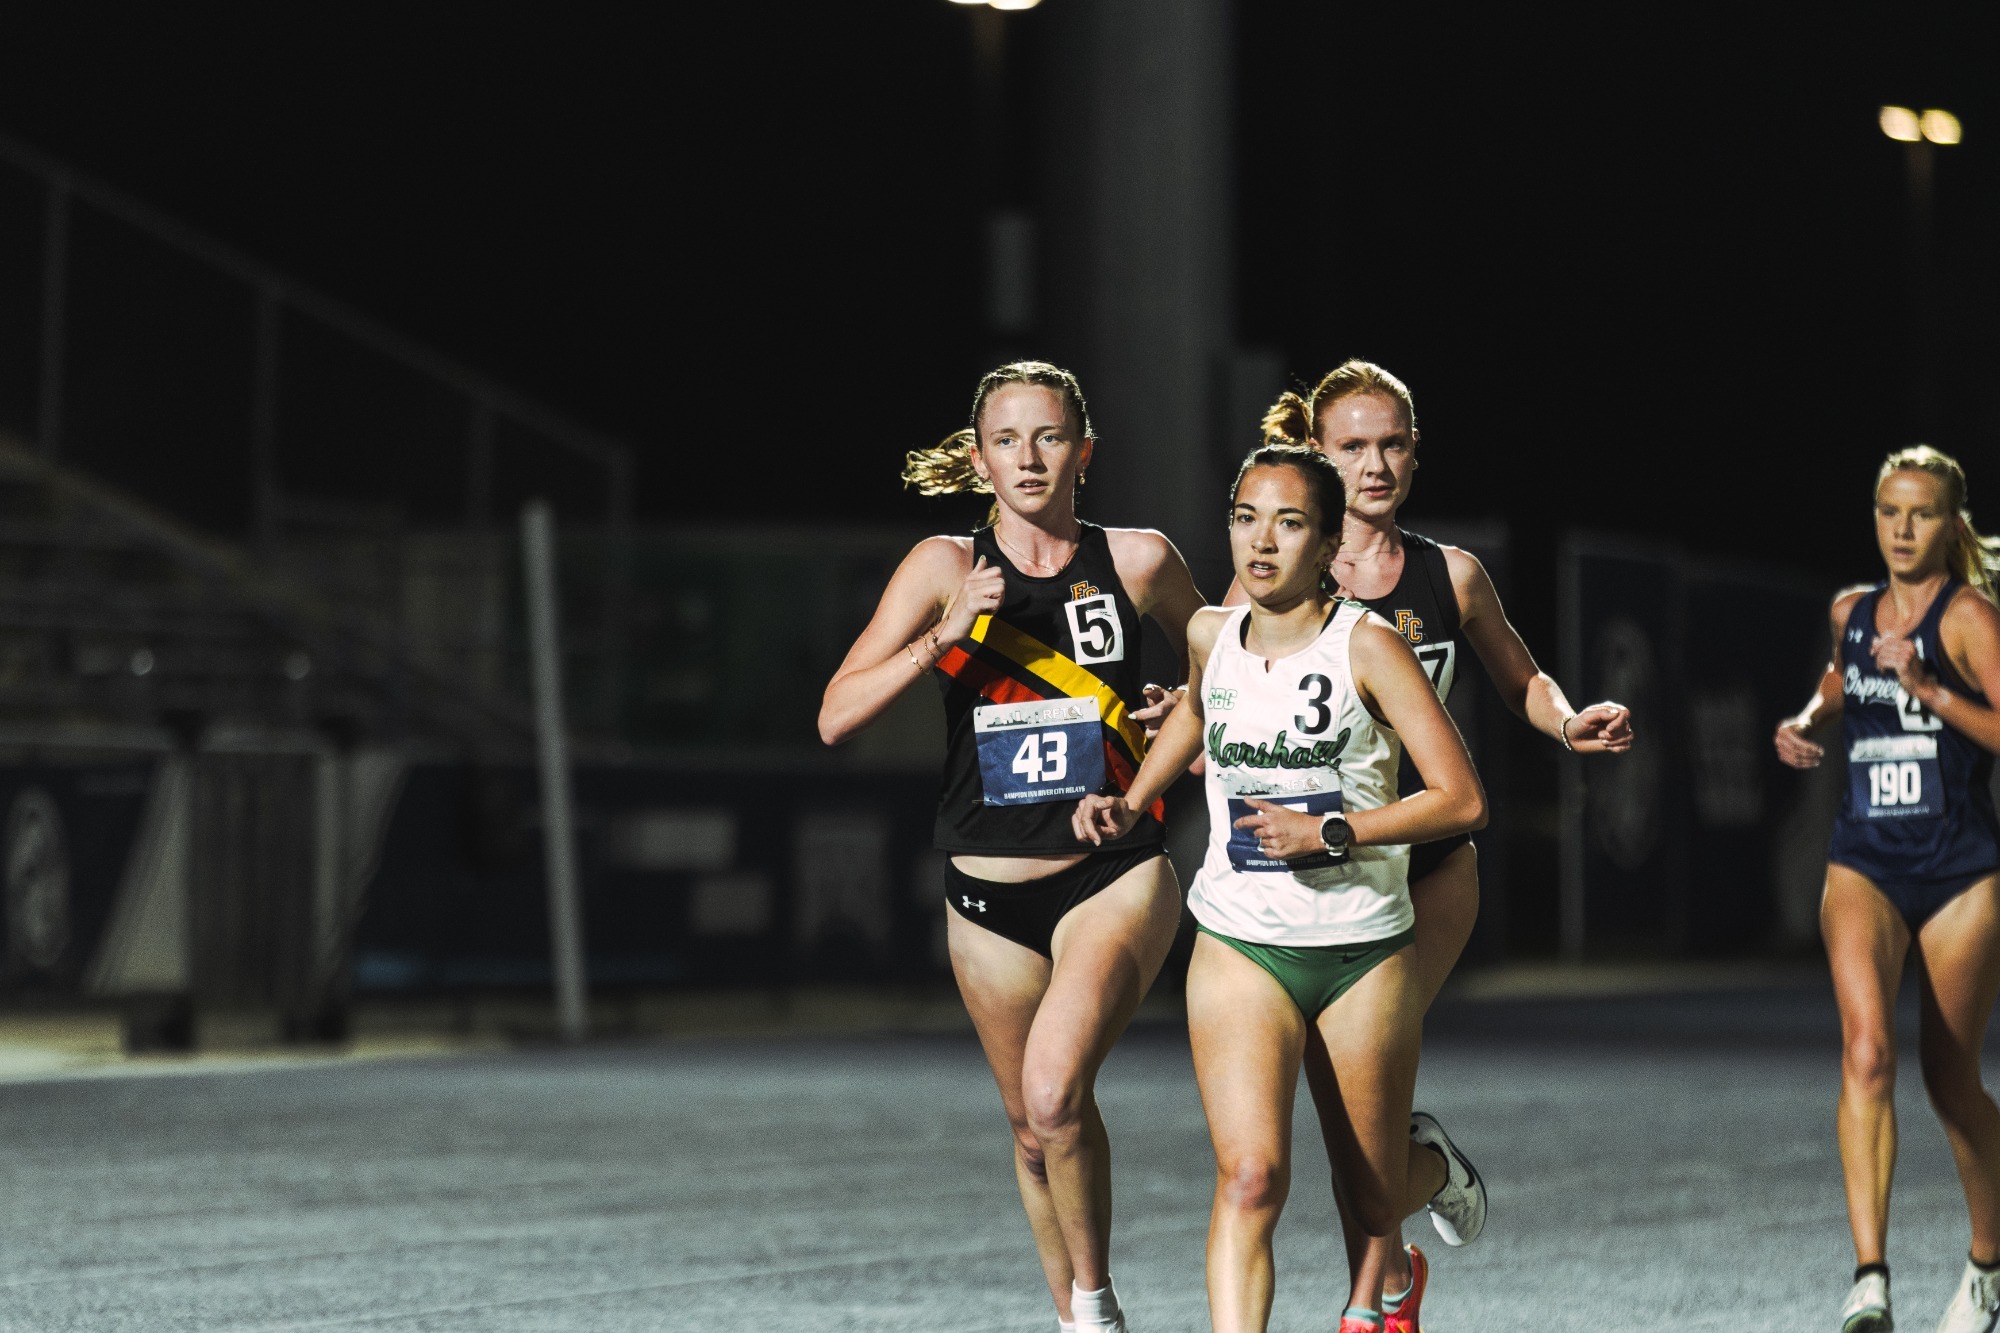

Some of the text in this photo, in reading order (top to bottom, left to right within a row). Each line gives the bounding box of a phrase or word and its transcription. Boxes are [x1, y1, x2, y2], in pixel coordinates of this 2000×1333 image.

[1075, 600, 1115, 658] 5
[1394, 610, 1423, 643] FC
[1419, 648, 1448, 692] 7
[1207, 688, 1238, 710] SBC
[1294, 673, 1333, 735] 3
[1012, 731, 1068, 784] 43
[1208, 722, 1352, 770] Marshall
[1003, 792, 1027, 800] HAMPTON
[1028, 790, 1038, 798] INN
[1038, 789, 1054, 797] RIVER
[1065, 785, 1086, 794] RELAYS
[1868, 761, 1922, 807] 190
[1246, 859, 1268, 867] HAMPTON
